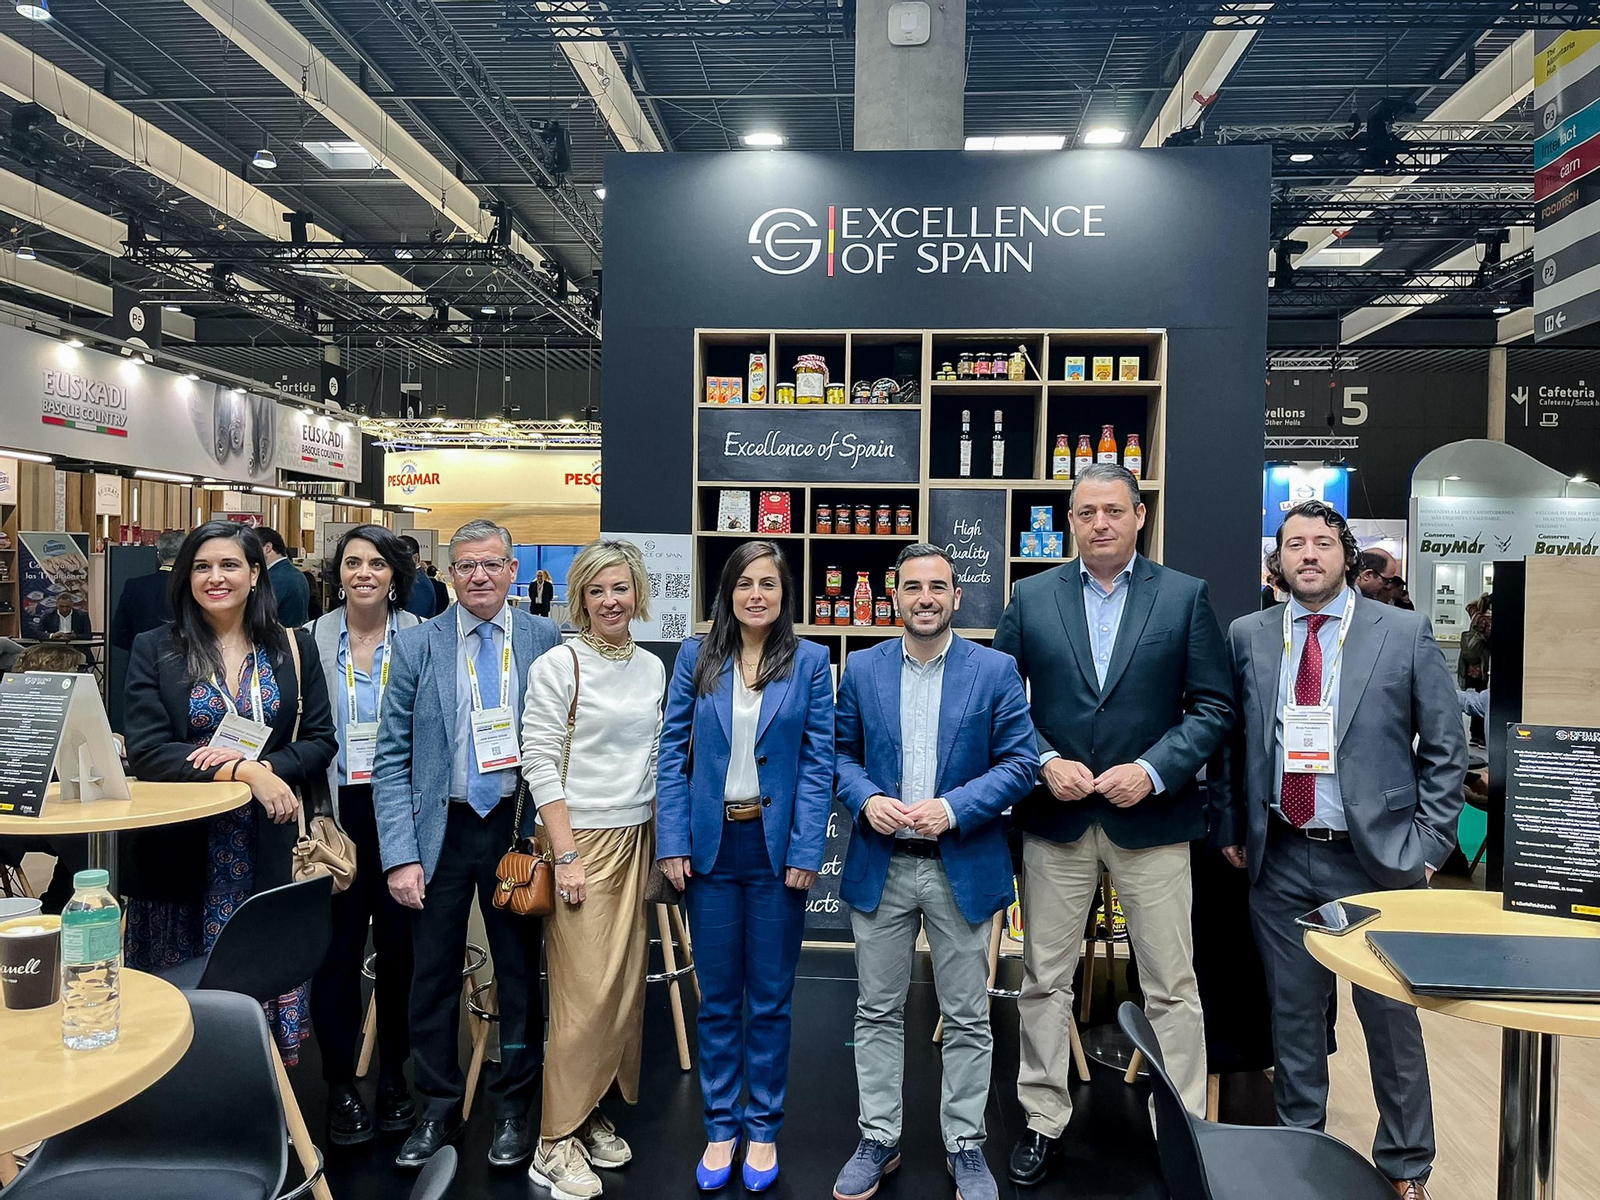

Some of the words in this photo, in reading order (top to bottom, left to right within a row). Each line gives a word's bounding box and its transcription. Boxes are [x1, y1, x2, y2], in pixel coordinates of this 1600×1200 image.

[1545, 109, 1555, 124] P3
[841, 205, 1106, 239] EXCELLENCE
[841, 242, 898, 274] OF
[916, 241, 1033, 274] SPAIN
[1544, 265, 1554, 279] P2
[132, 313, 142, 326] P5
[43, 368, 127, 410] EUSKADI
[274, 381, 316, 392] Sortida
[1539, 386, 1595, 398] Cafeteria
[42, 399, 81, 419] BASQUE
[81, 407, 128, 427] COUNTRY
[1265, 407, 1306, 418] vellons
[1342, 386, 1369, 426] 5
[302, 424, 344, 449] EUSKADI
[301, 444, 320, 457] BASQUE
[320, 448, 344, 461] COUNTRY
[724, 431, 815, 457] Excellence
[818, 431, 840, 461] of
[838, 433, 895, 469] Spain
[388, 473, 441, 487] PESCAMAR
[564, 473, 602, 486] PESC
[953, 519, 982, 543] High
[944, 543, 990, 567] Quality
[957, 566, 992, 583] ducts
